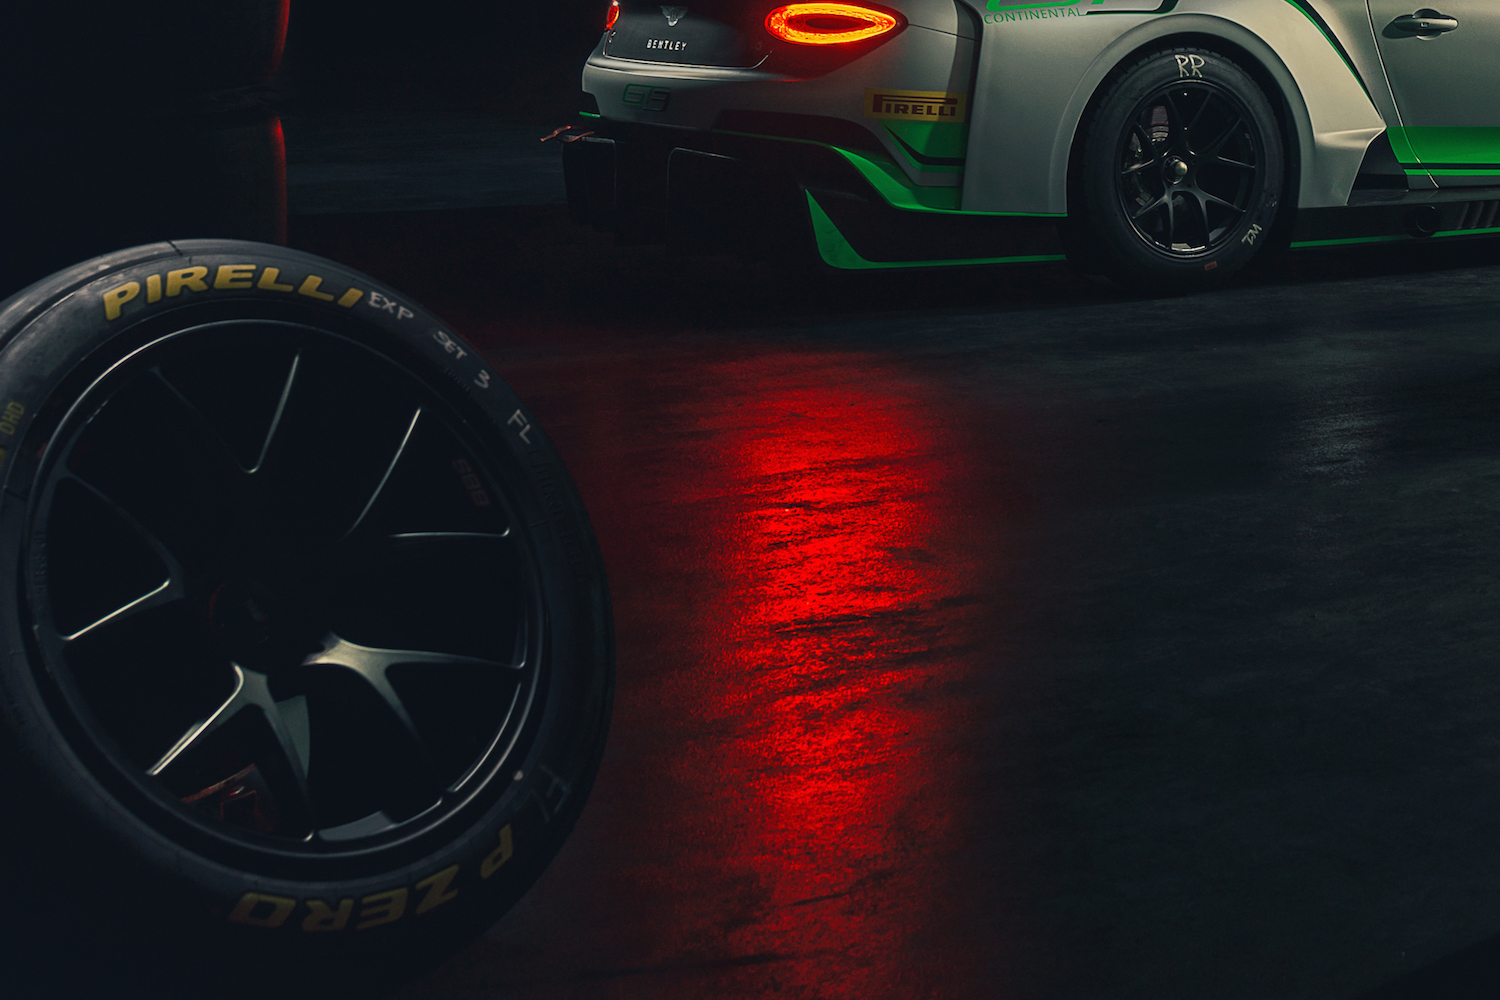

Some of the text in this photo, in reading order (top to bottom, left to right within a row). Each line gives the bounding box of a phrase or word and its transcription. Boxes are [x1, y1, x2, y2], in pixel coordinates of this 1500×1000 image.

[983, 6, 1083, 25] CONTINENTAL
[646, 38, 688, 51] BENTLEY
[1174, 53, 1206, 79] RR
[873, 94, 958, 117] PIRELLI
[102, 263, 364, 322] PIRELLI
[368, 291, 415, 322] EXP
[432, 329, 469, 361] SET
[473, 369, 492, 390] 3
[506, 408, 534, 445] FL
[229, 823, 514, 933] P ZERO
